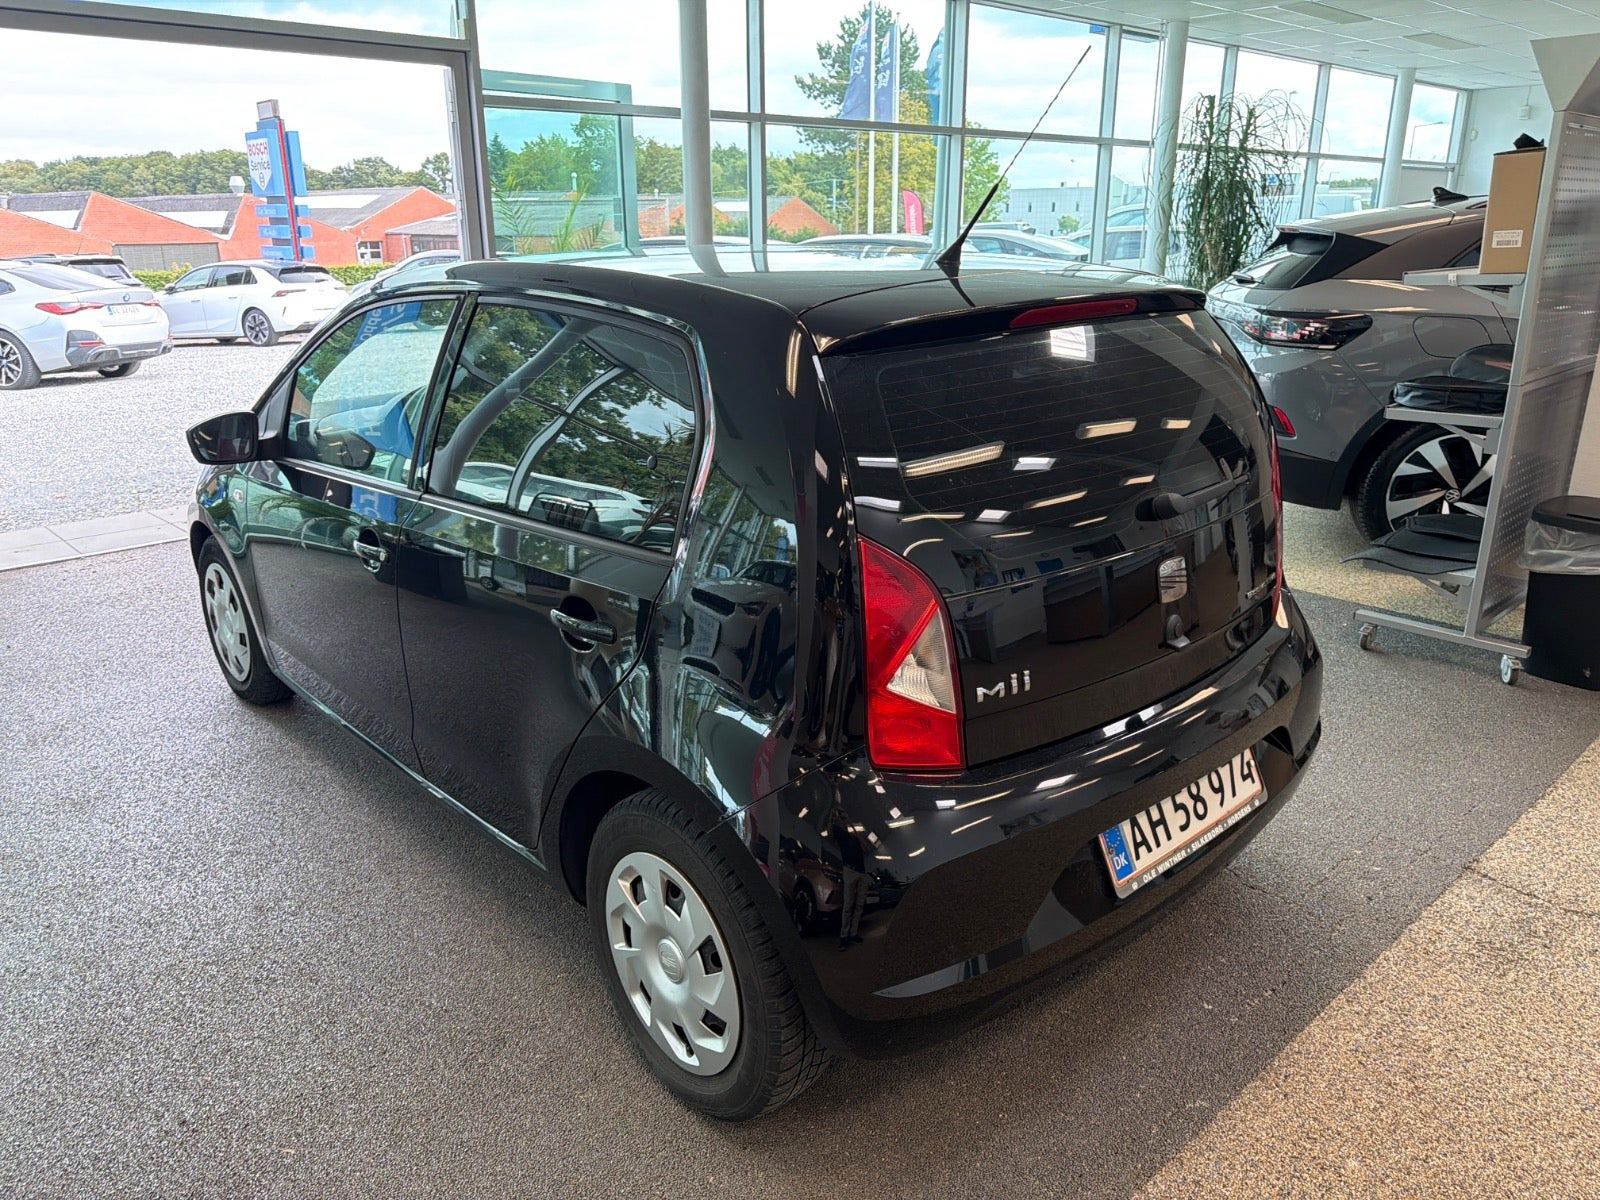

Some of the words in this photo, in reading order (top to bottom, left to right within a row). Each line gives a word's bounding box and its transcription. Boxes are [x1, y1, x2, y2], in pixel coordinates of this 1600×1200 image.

[248, 141, 268, 156] BOSCH
[250, 158, 271, 171] Service
[976, 670, 1030, 703] Mii
[1128, 802, 1172, 861] AH
[1171, 780, 1209, 832] 58
[1207, 751, 1256, 808] 974
[1142, 870, 1157, 884] OLE
[1156, 849, 1187, 873] WINTHER
[1191, 824, 1224, 851] SILKEBORG
[1227, 805, 1252, 827] HORSENS
[1113, 852, 1129, 870] DK
